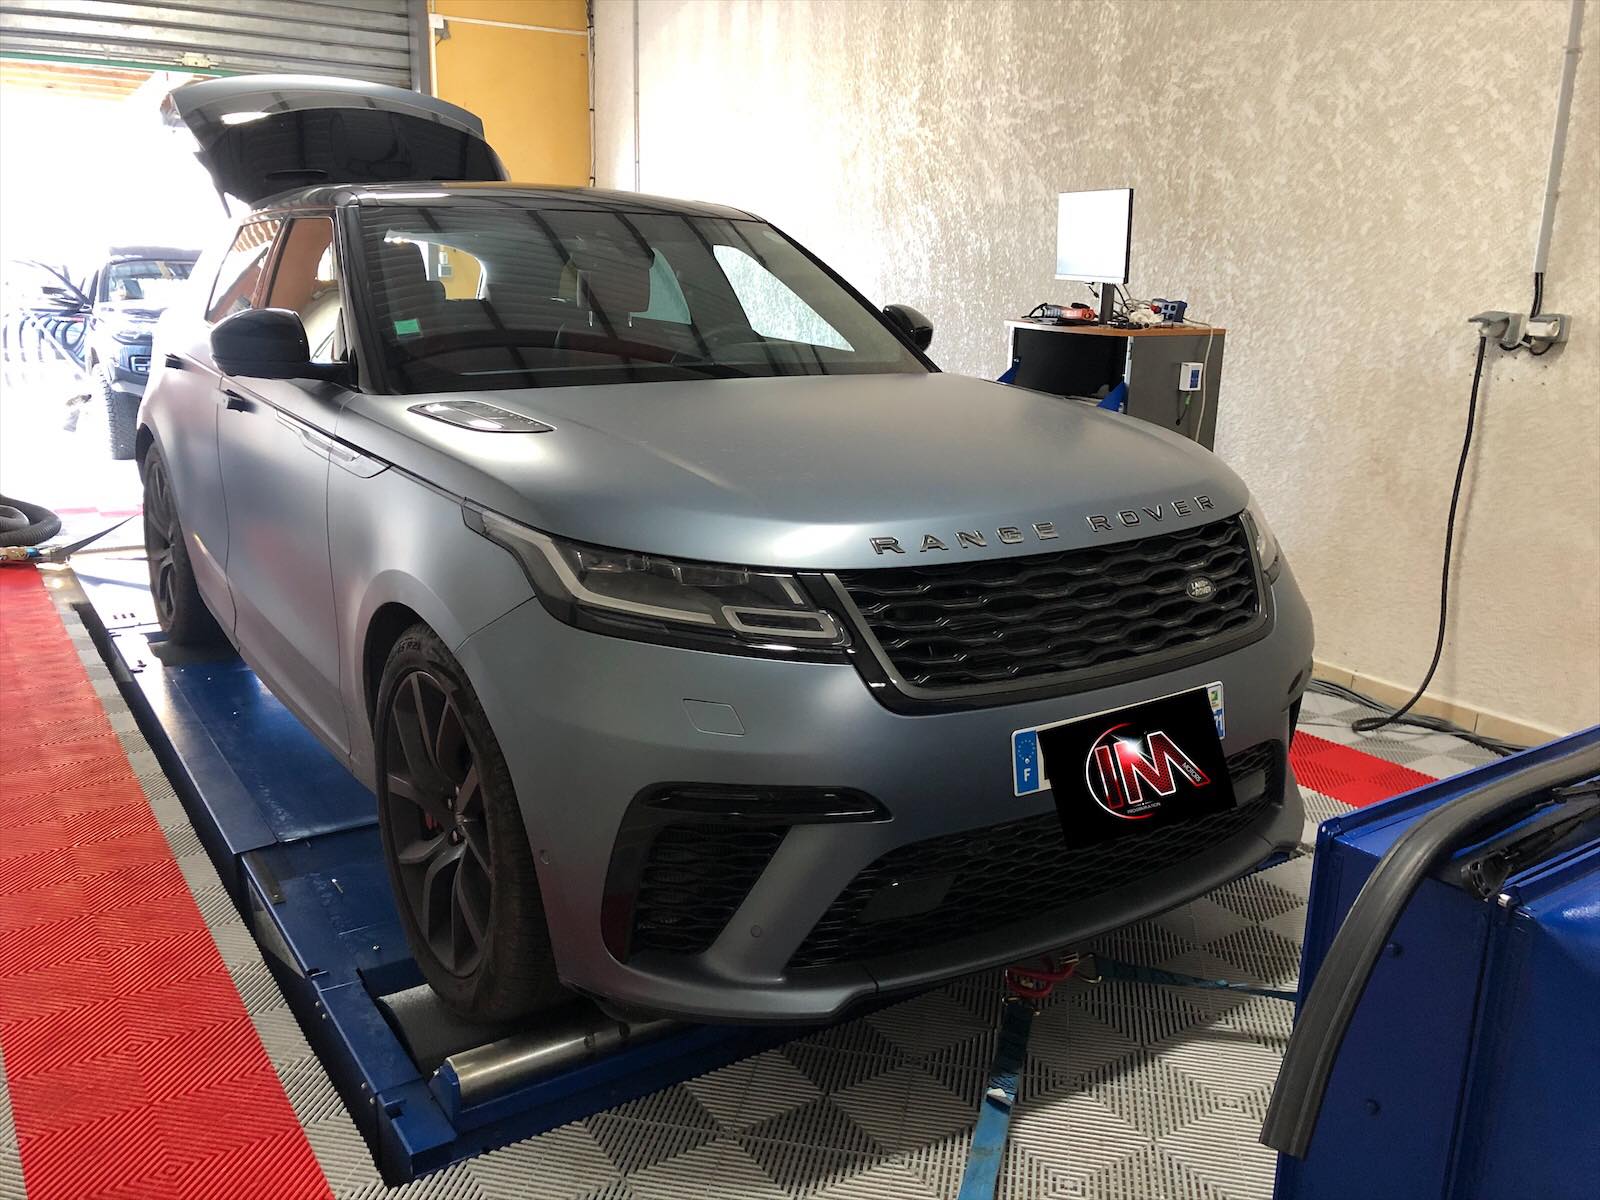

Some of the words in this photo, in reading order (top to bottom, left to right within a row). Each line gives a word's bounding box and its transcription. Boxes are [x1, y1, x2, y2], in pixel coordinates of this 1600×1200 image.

[869, 521, 1059, 555] RANGE
[1085, 494, 1216, 532] ROVER
[1023, 767, 1032, 783] F
